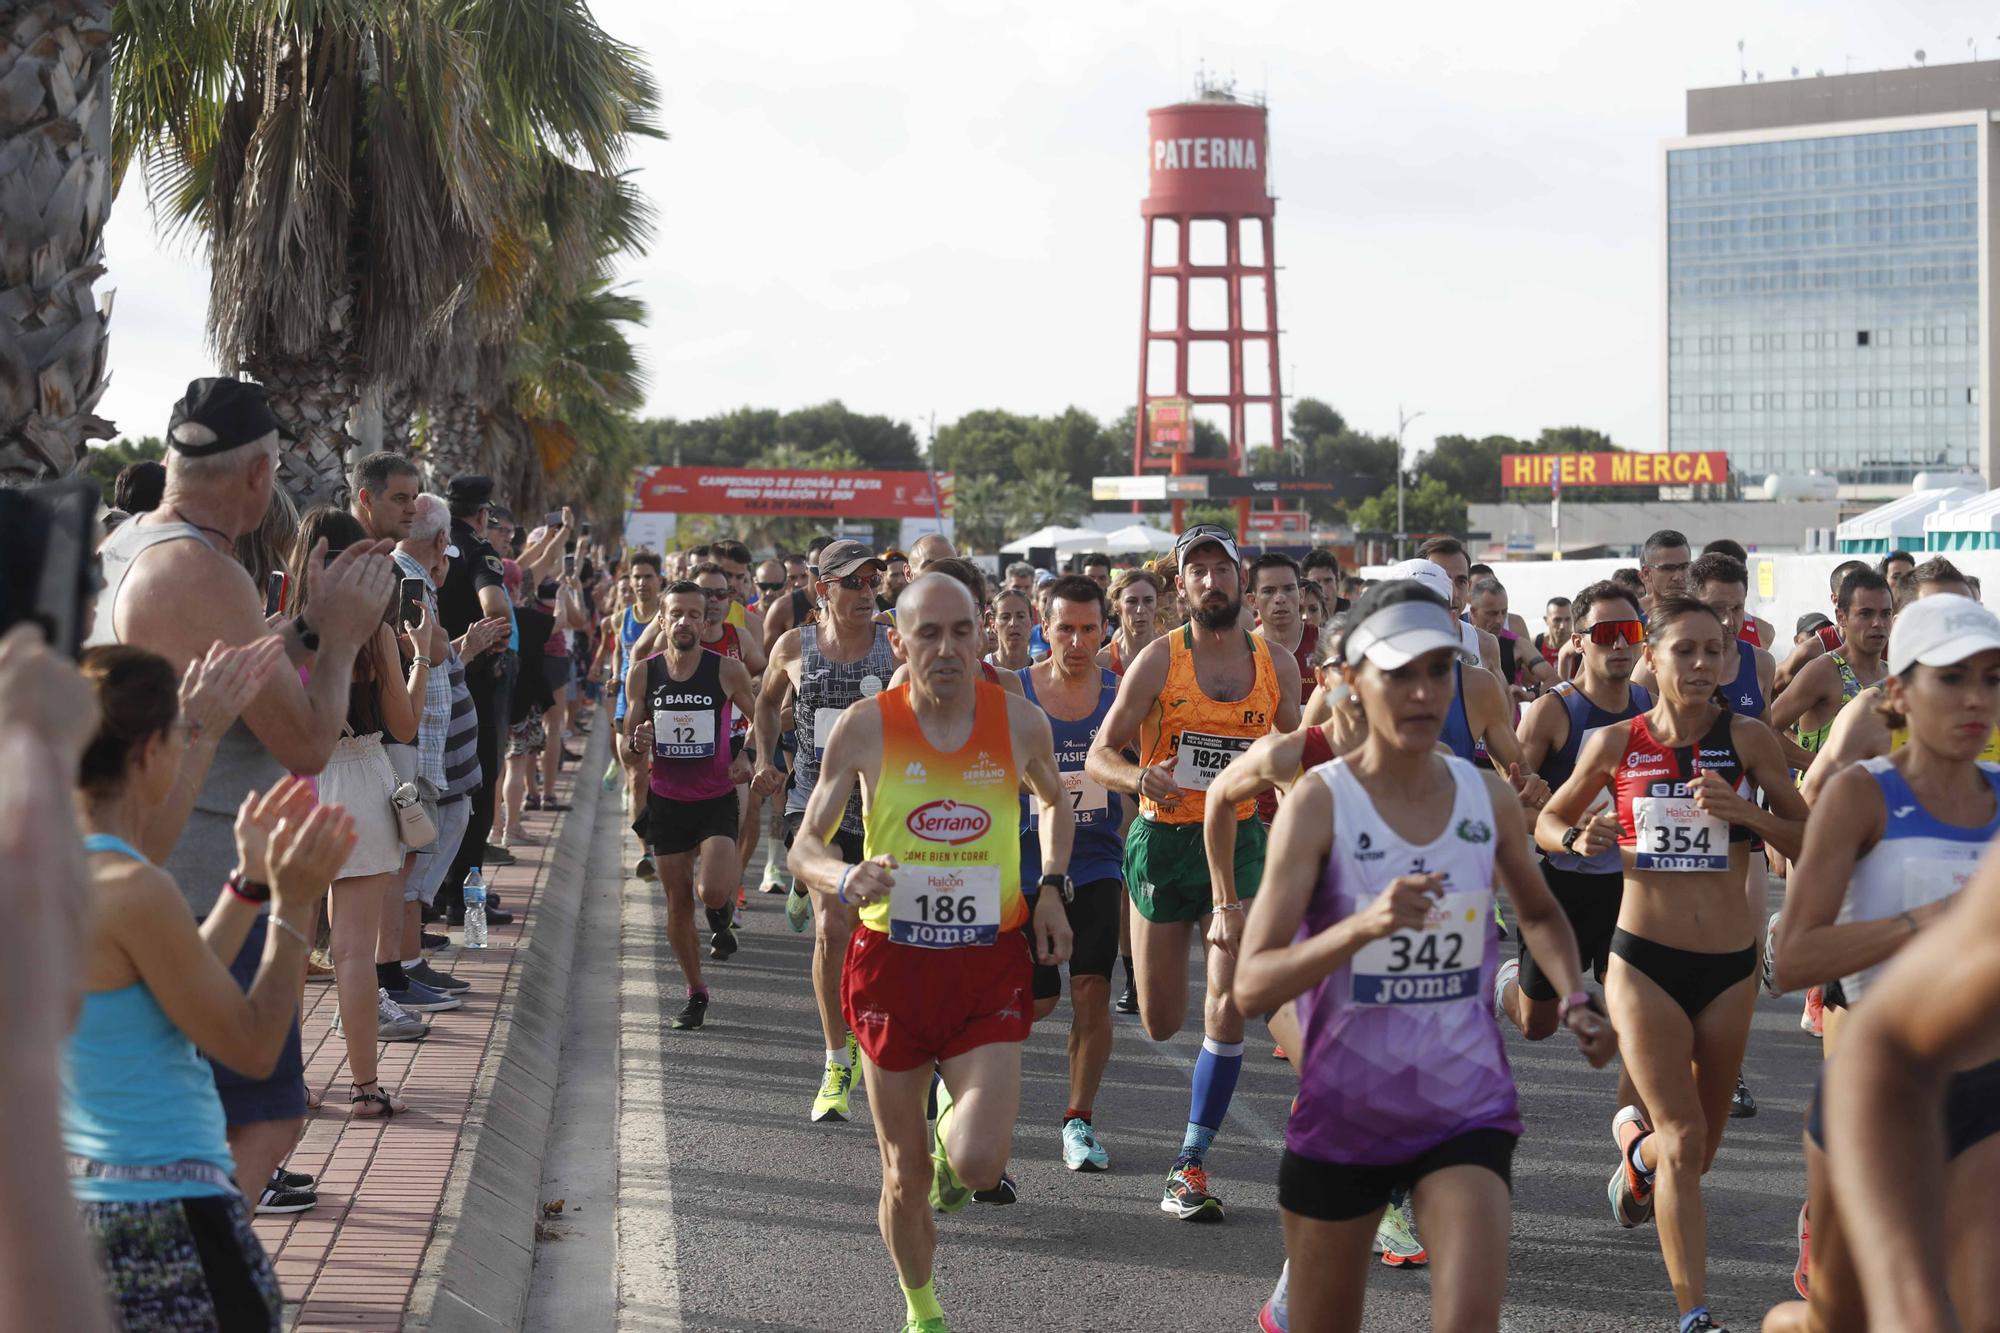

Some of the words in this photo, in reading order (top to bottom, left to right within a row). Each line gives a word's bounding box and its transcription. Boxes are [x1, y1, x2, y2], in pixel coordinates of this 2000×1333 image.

[1154, 137, 1257, 171] PATERNA
[1611, 453, 1713, 482] MERCA
[665, 694, 713, 705] BARCO
[1243, 710, 1265, 724] R's
[673, 727, 695, 743] 12
[1055, 751, 1088, 762] TASIE
[1192, 748, 1232, 770] 1926
[1199, 769, 1217, 779] IVAN
[1070, 791, 1084, 810] 7
[915, 811, 984, 832] Serrano
[1654, 826, 1711, 854] 354
[929, 851, 950, 861] BIEN
[953, 851, 958, 861] Y
[961, 850, 989, 861] CORRE
[914, 895, 977, 924] 186
[1387, 932, 1464, 973] 342
